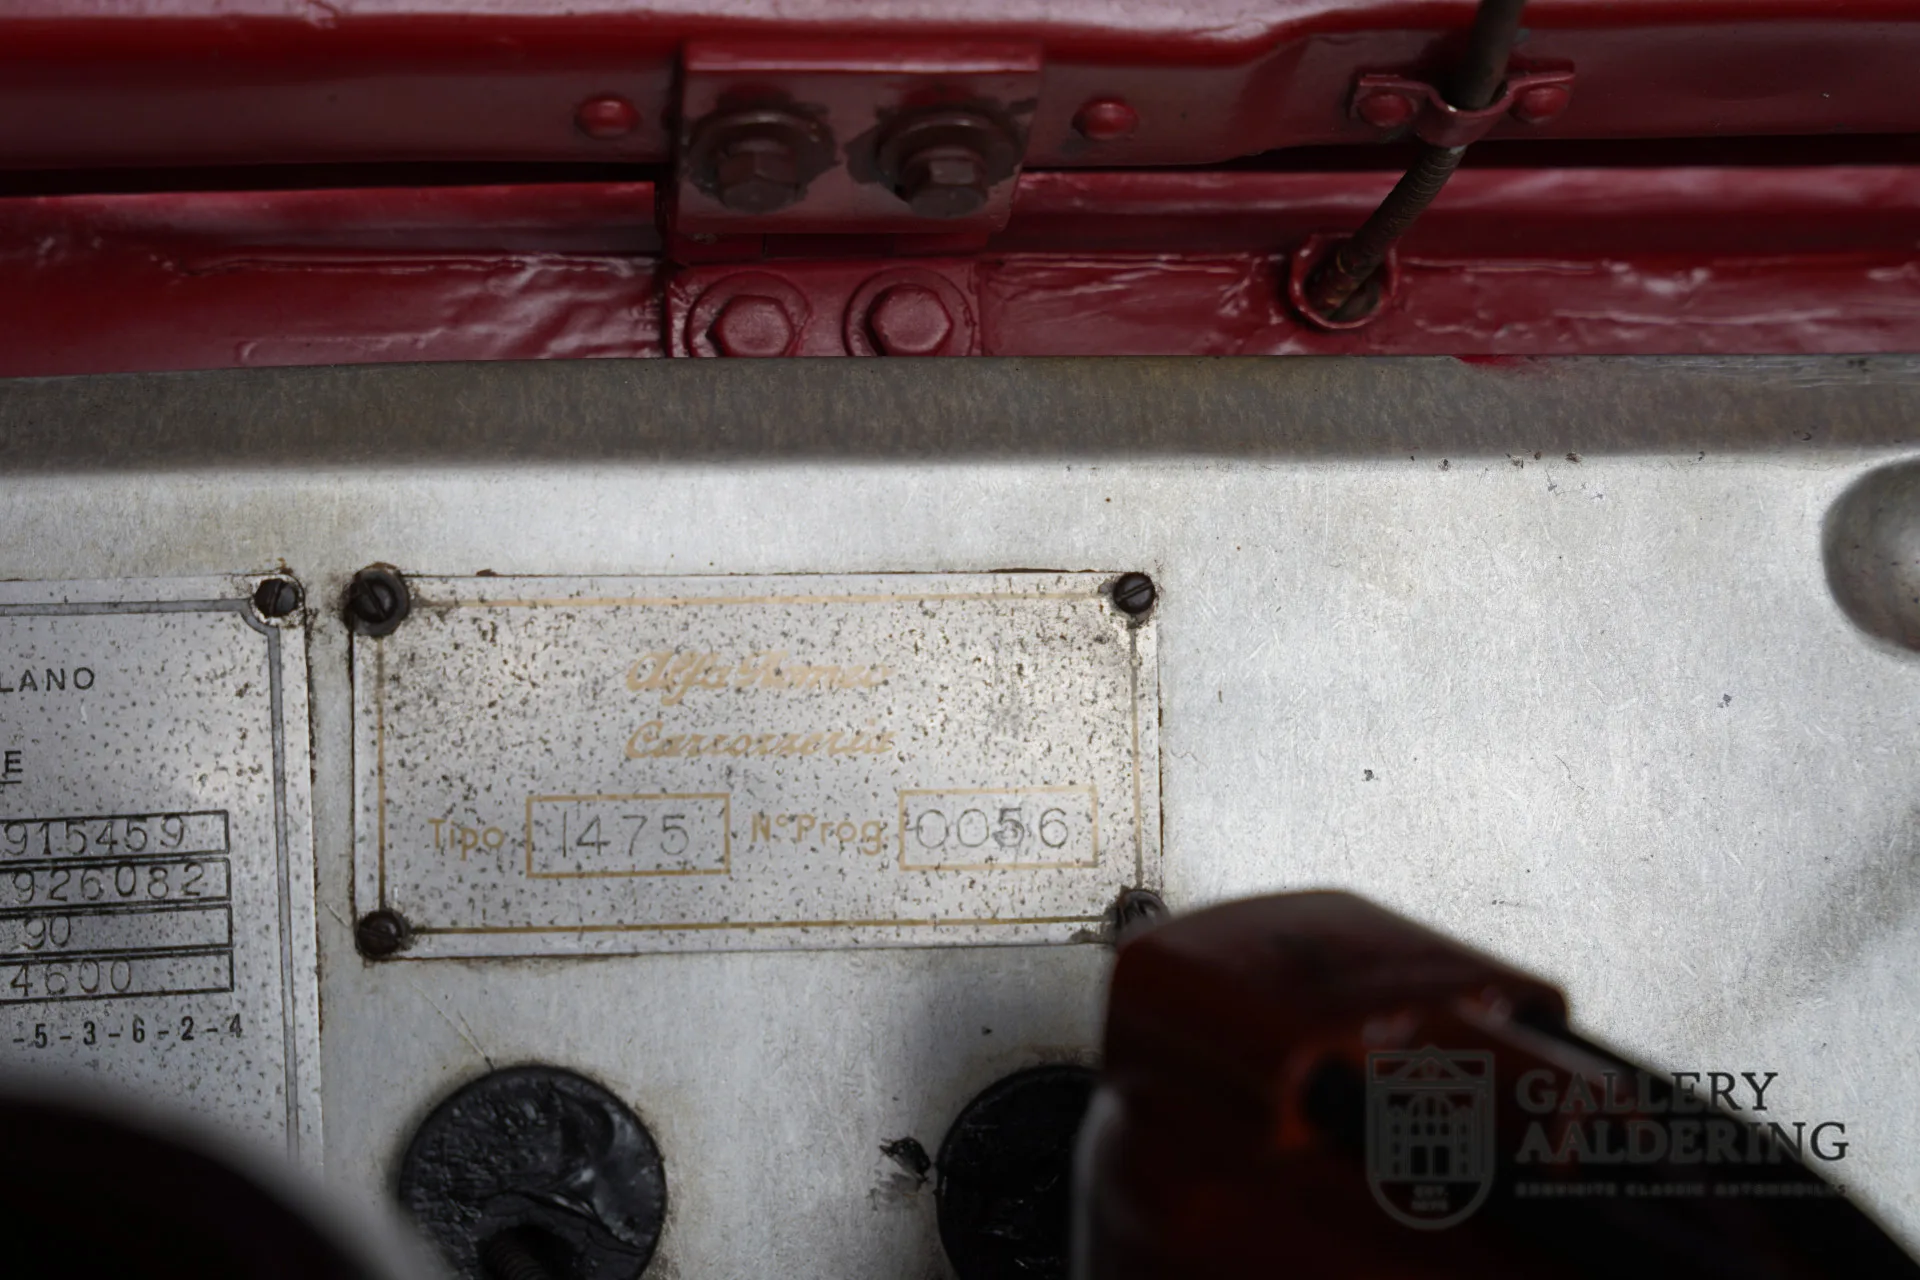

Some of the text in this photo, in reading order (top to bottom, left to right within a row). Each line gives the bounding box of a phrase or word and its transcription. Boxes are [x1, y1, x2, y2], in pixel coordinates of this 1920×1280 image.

[626, 648, 727, 706] Alfa
[427, 817, 505, 862] Tipo
[561, 811, 690, 858] 1475
[10, 959, 132, 997] 4600
